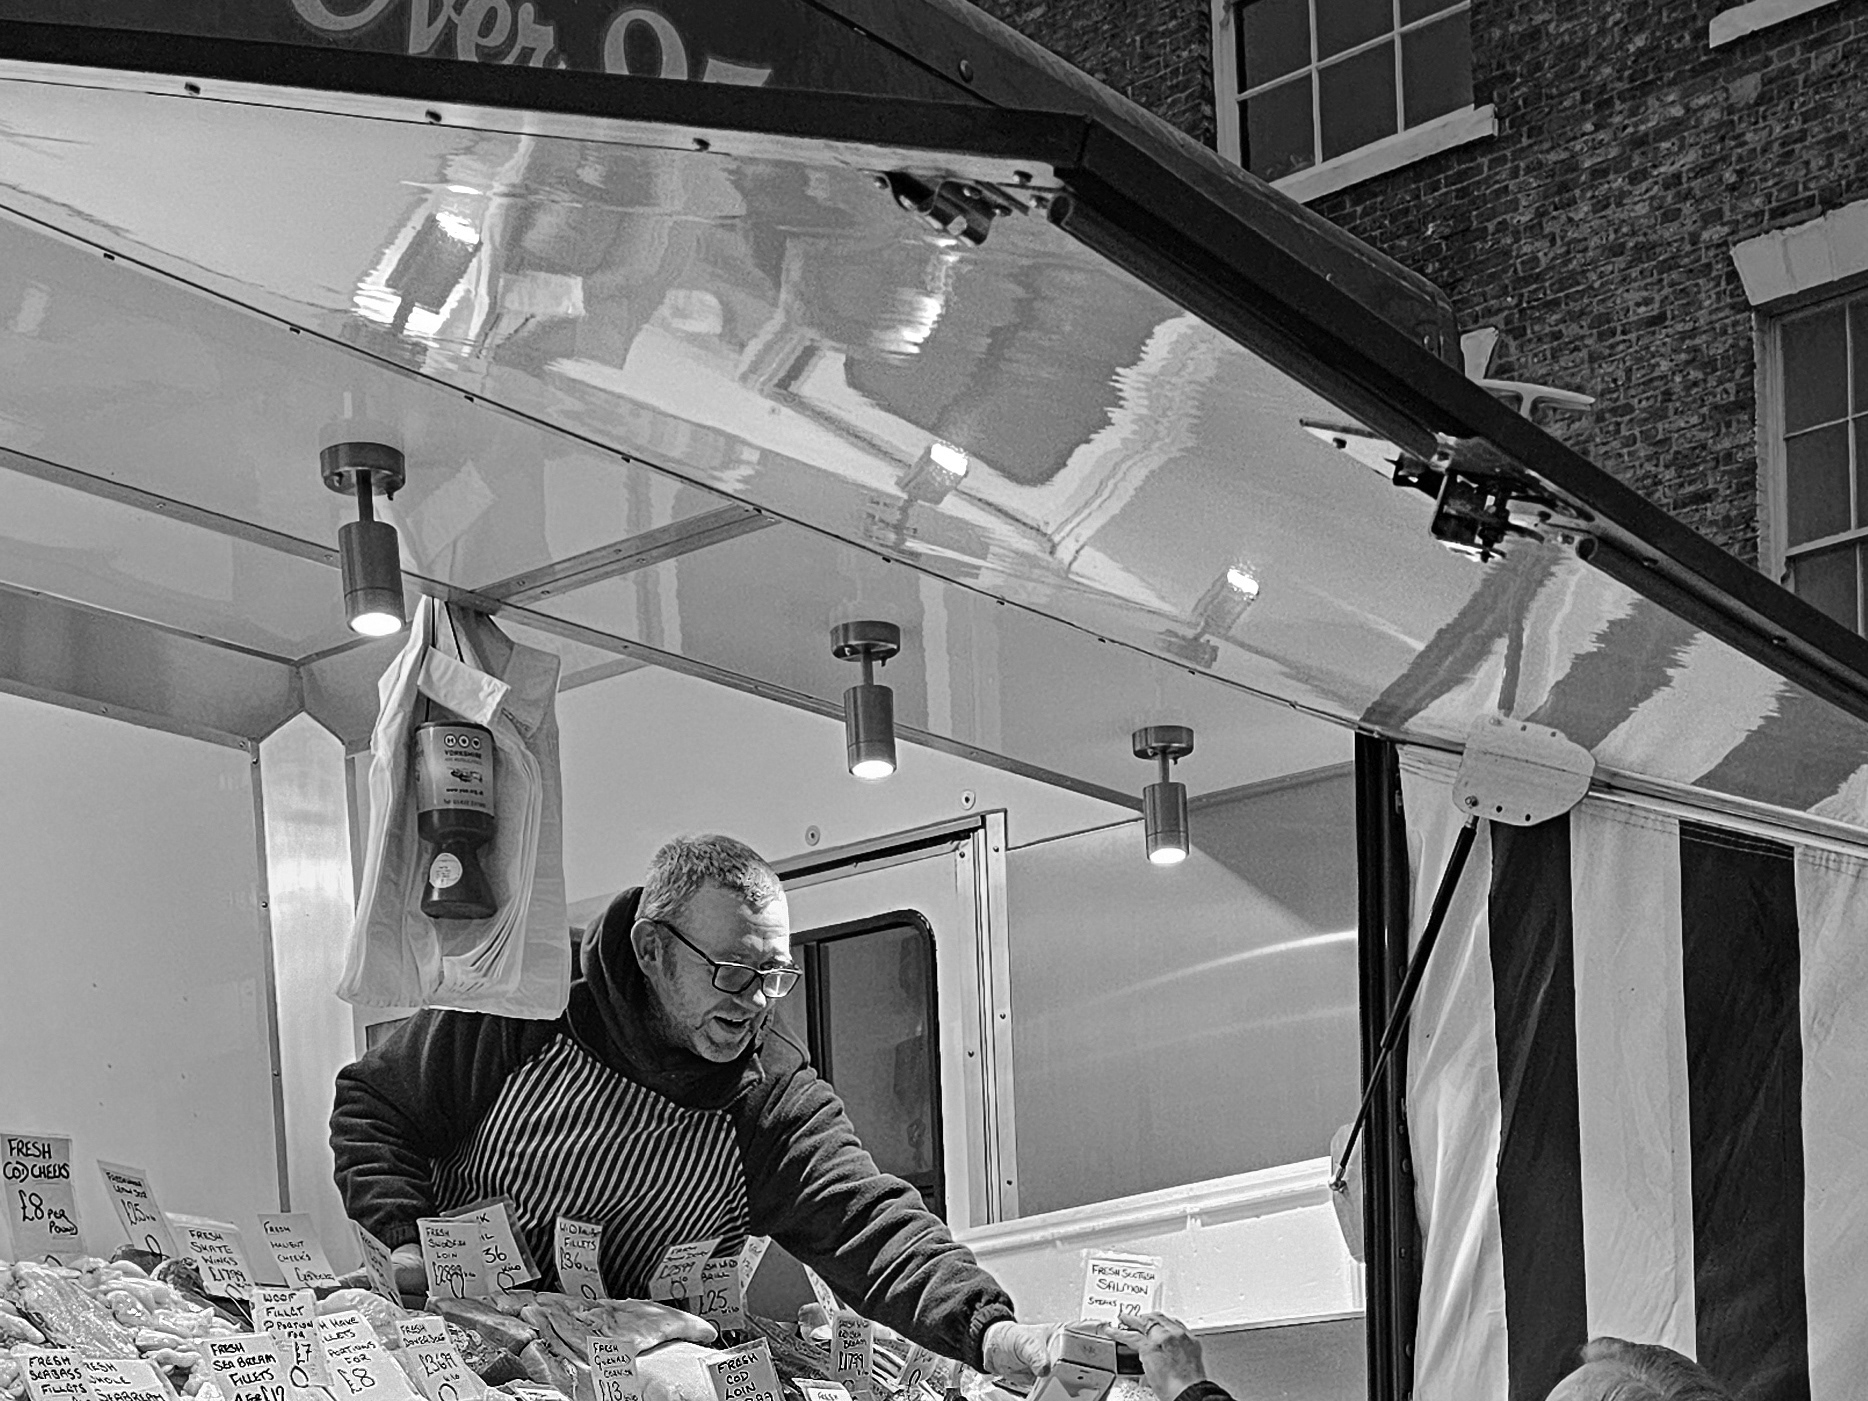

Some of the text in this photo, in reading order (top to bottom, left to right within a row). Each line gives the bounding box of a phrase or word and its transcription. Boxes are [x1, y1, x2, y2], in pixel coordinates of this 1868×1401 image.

[8, 1138, 52, 1159] FRESH
[31, 1162, 70, 1179] CHEEKS
[18, 1190, 44, 1222] £8
[189, 1229, 223, 1241] FRESH
[190, 1241, 233, 1254] SKATE
[564, 1236, 597, 1251] FILLETS
[201, 1255, 238, 1266] WINGS
[437, 1251, 458, 1261] LOIN
[1091, 1263, 1120, 1276] FRESH
[1096, 1278, 1148, 1295] SALMON
[263, 1293, 297, 1302] WOOF
[699, 1288, 729, 1315] £25
[265, 1306, 305, 1317] FILLET
[263, 1320, 274, 1331] 2
[210, 1342, 245, 1356] FRESH
[294, 1341, 312, 1365] £7
[592, 1342, 619, 1353] FRESH
[30, 1355, 72, 1367] FRESH
[213, 1354, 277, 1371] SEA BREAM
[717, 1353, 759, 1374] FRESH
[30, 1368, 82, 1381] SEABASS
[229, 1368, 275, 1386] FILLETS
[337, 1367, 376, 1394] £8
[726, 1371, 749, 1385] COD
[41, 1383, 88, 1395] FILLETS
[726, 1381, 756, 1400] LOIN
